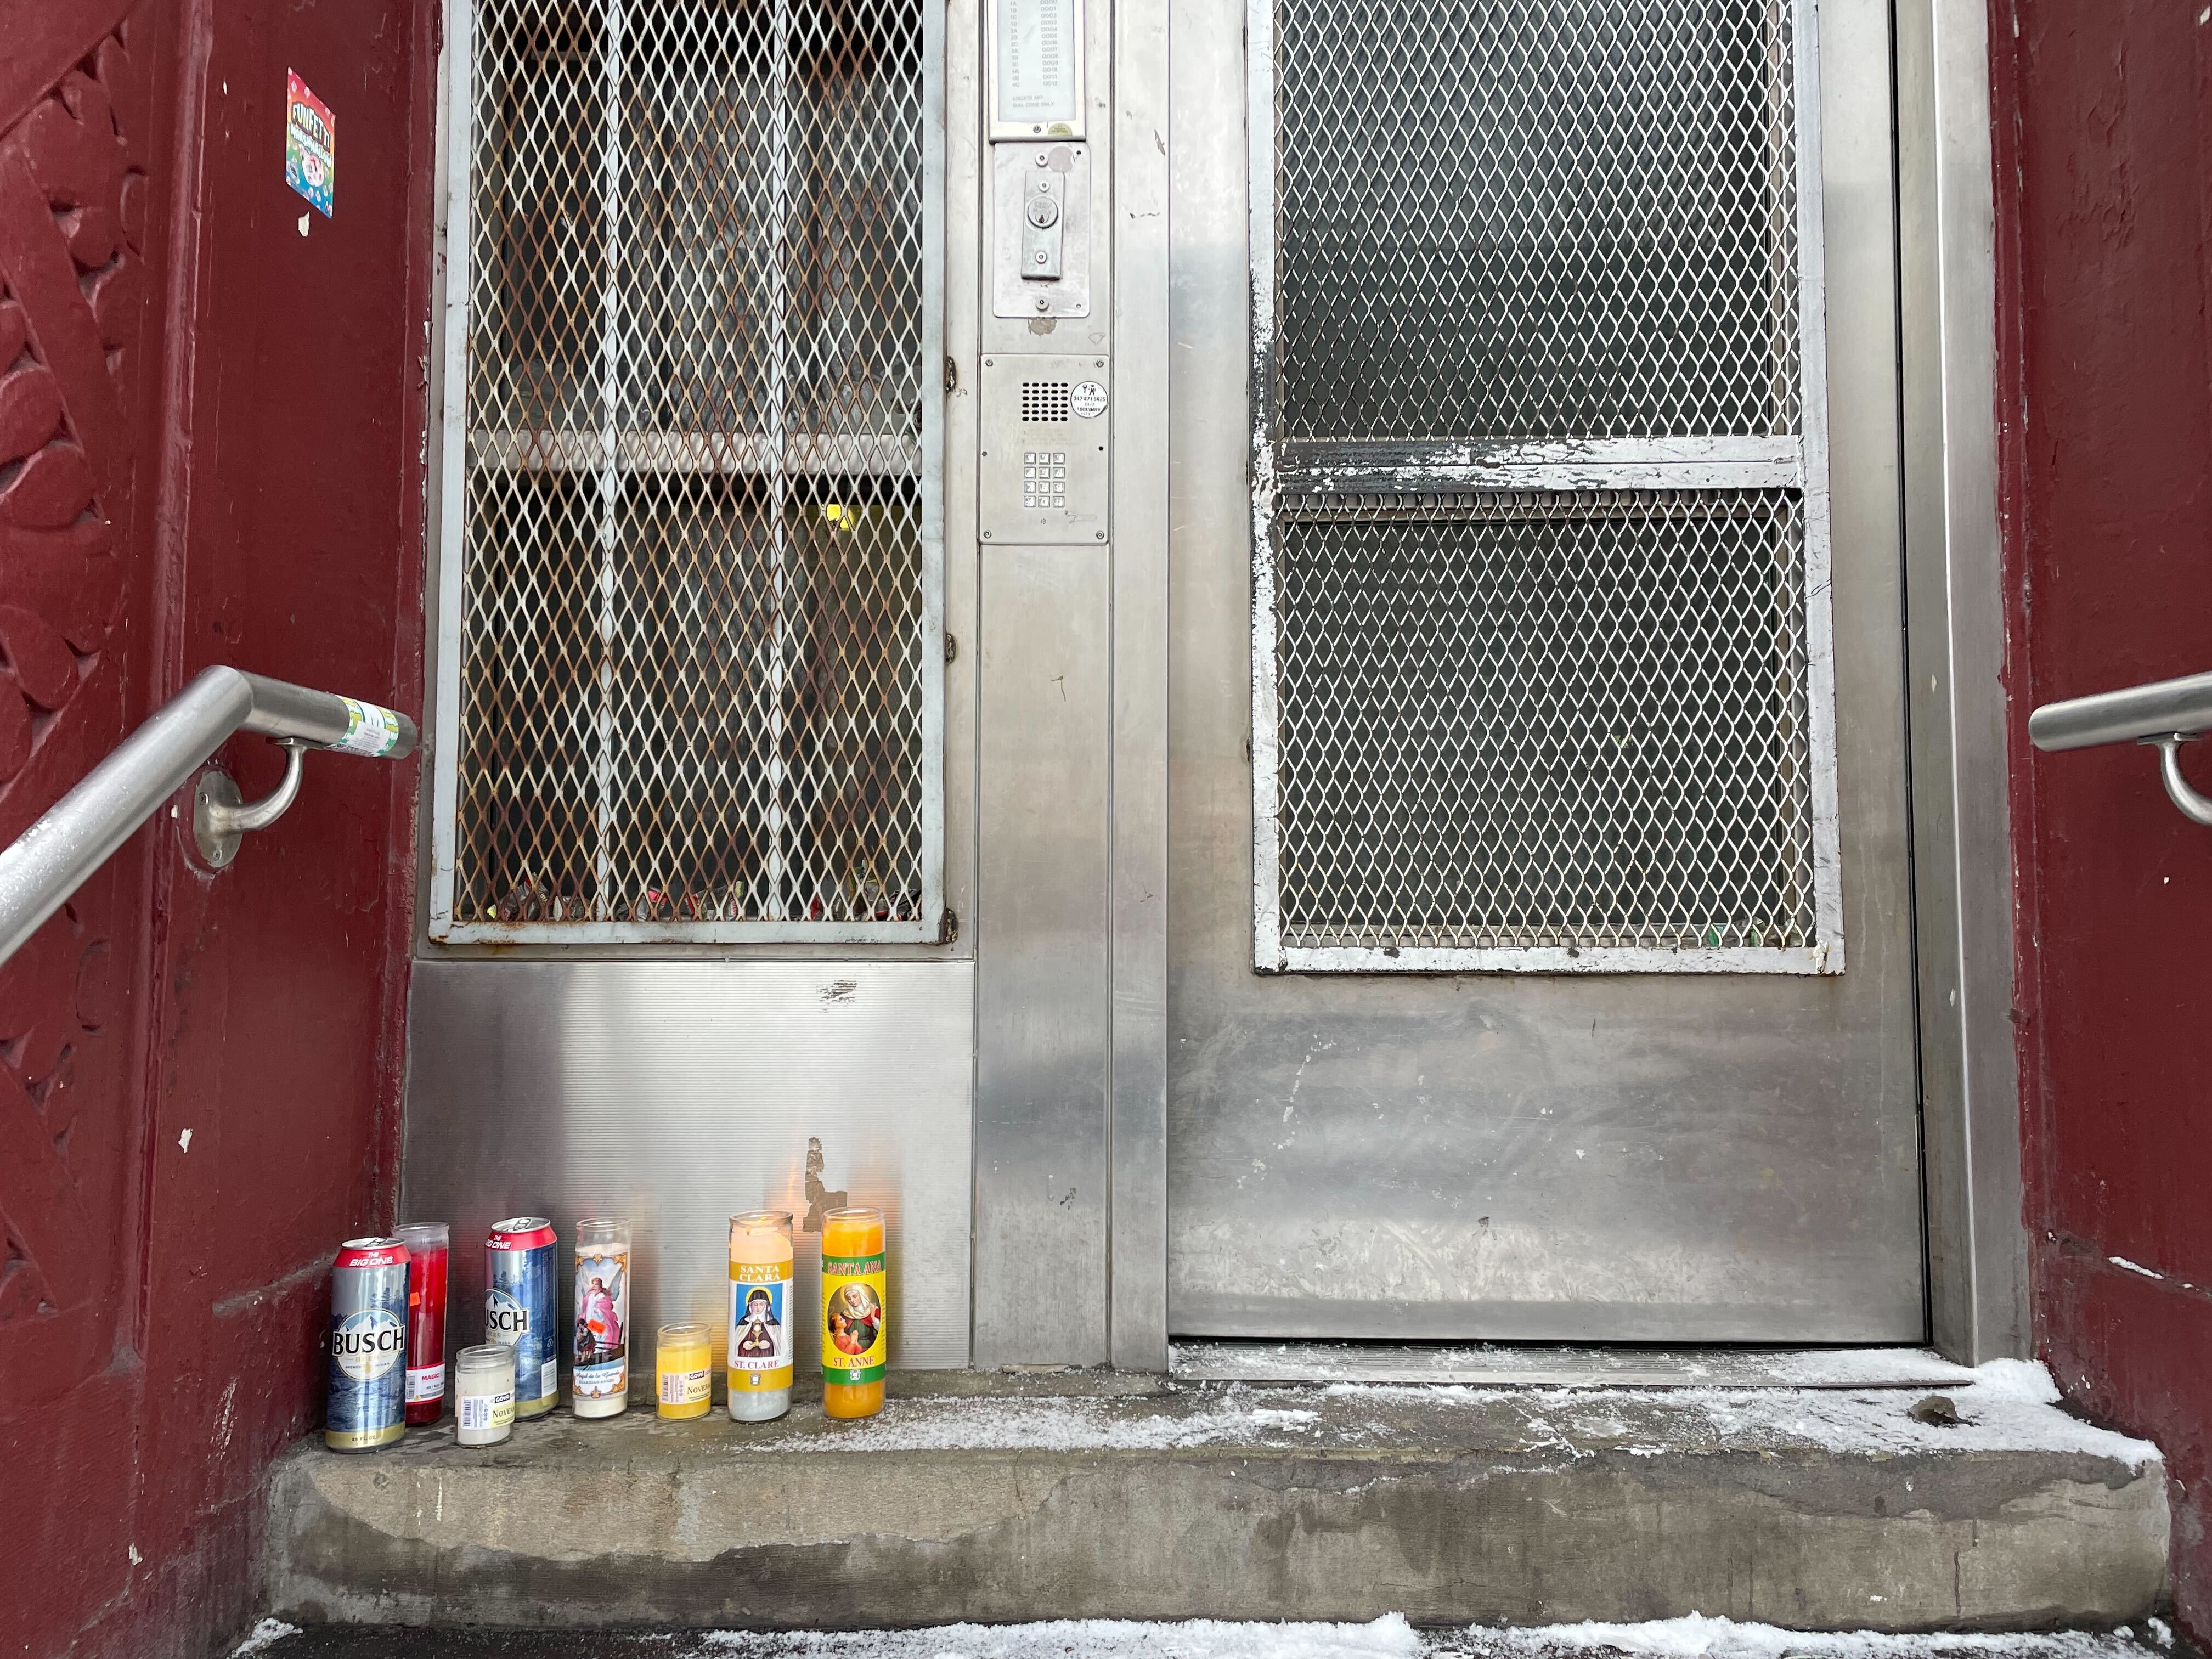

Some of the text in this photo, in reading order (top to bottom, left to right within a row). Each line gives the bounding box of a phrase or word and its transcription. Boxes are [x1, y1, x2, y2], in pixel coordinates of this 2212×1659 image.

[292, 103, 330, 151] FUNFETTI
[290, 124, 331, 168] MARSHMALLOW
[369, 1256, 393, 1265] ONE
[740, 1265, 780, 1273] SANTA
[827, 1259, 882, 1276] SANTA ANA
[739, 1273, 781, 1282] CLARA
[333, 1327, 405, 1355] BUSCH
[748, 1360, 779, 1369] CLARE
[834, 1356, 874, 1367] ST. ANNE
